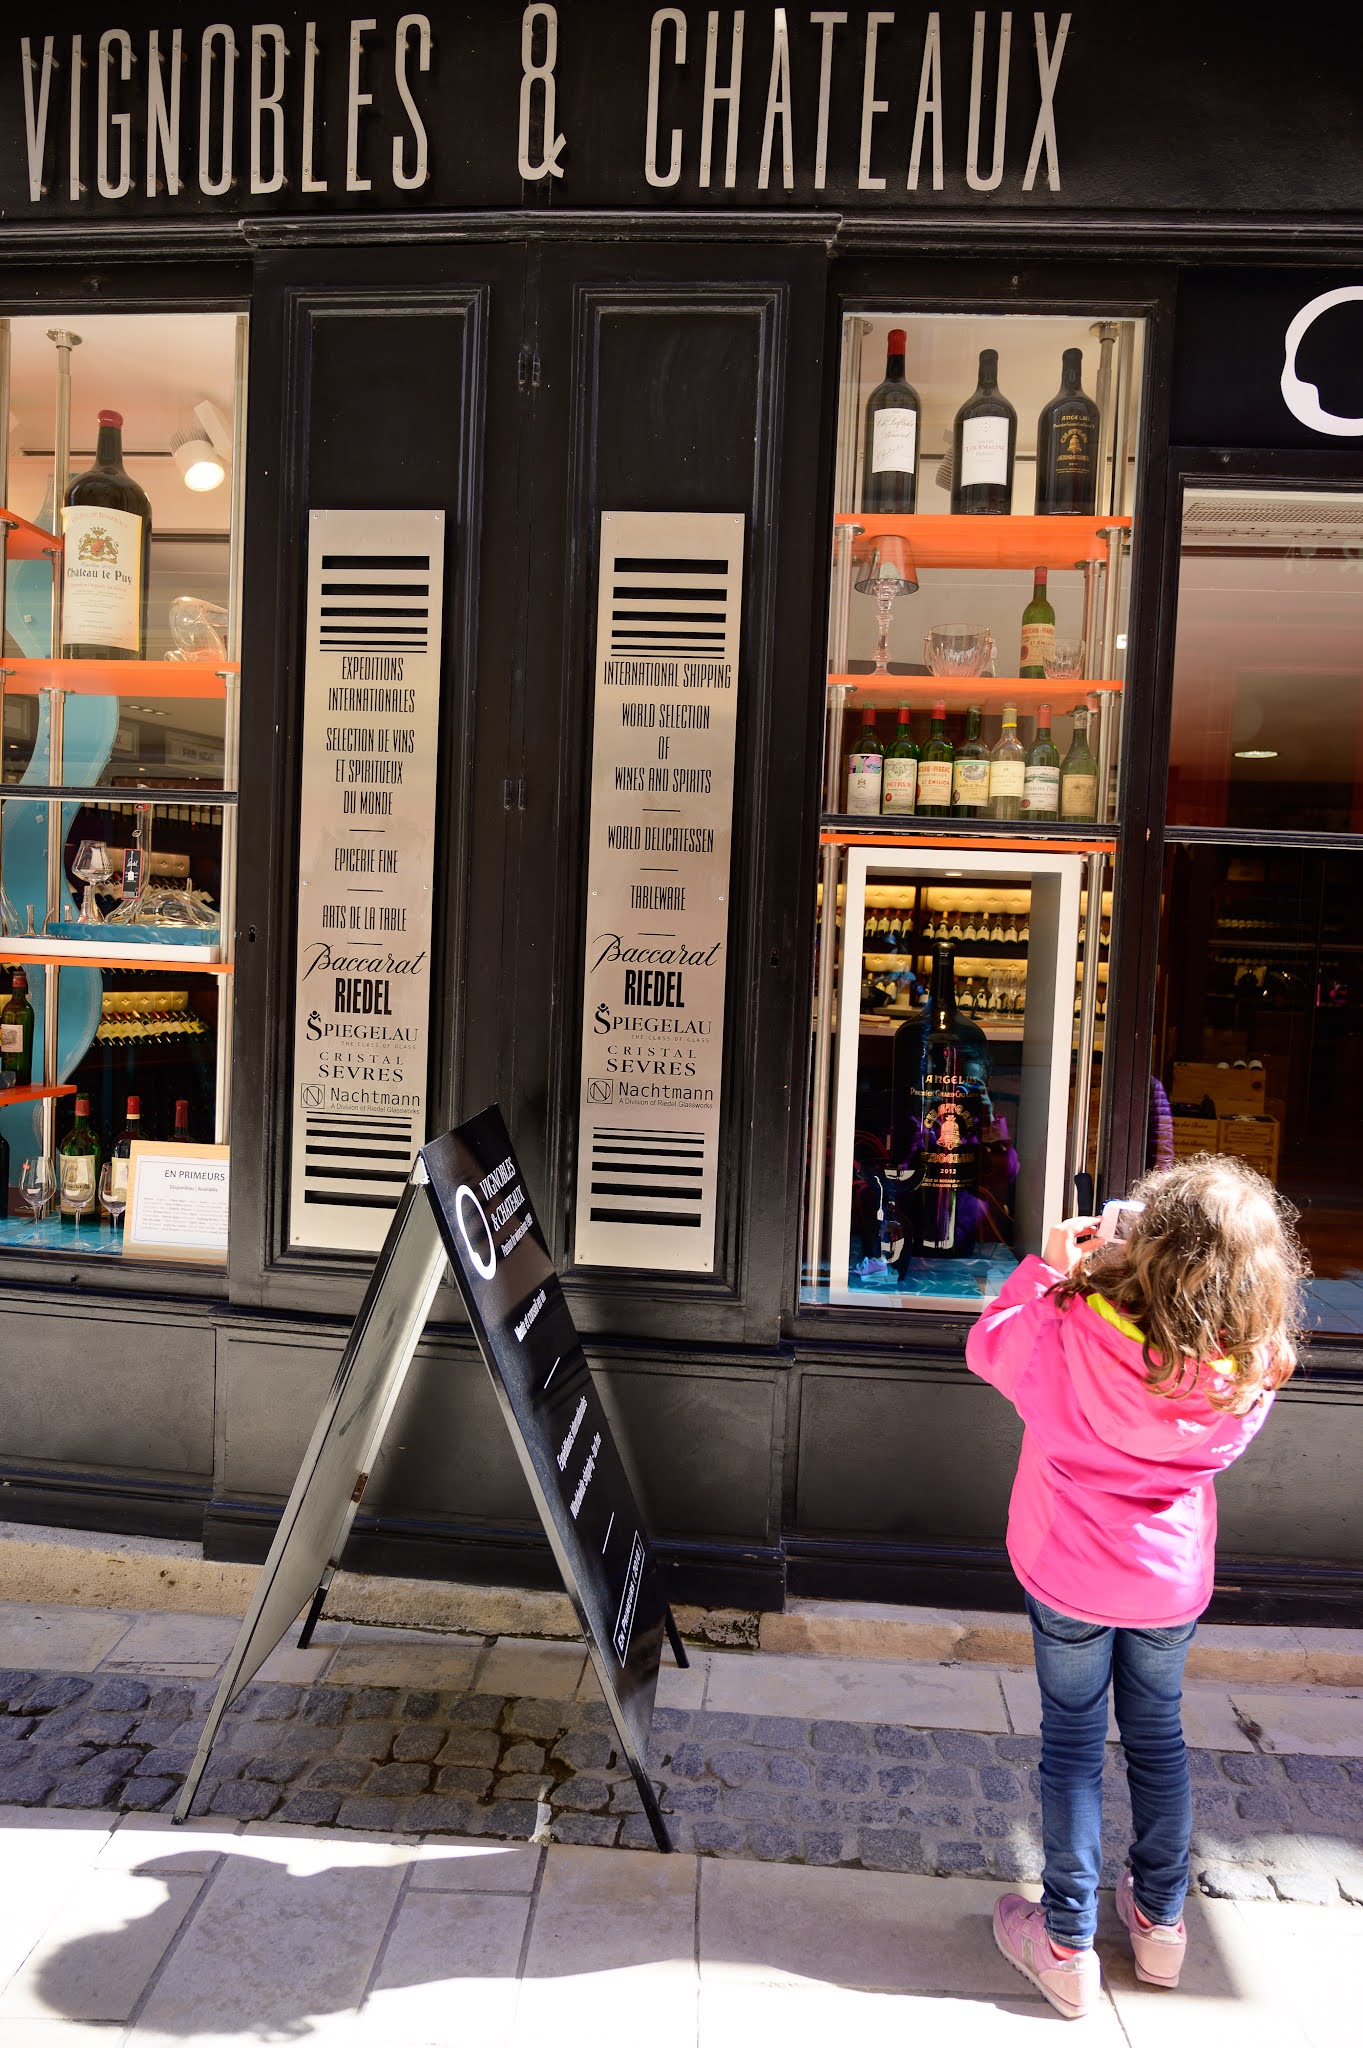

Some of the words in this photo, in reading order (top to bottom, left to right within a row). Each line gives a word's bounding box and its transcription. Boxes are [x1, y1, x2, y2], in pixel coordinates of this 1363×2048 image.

[20, 23, 433, 202] VIGNOBLES
[516, 2, 567, 180] &
[645, 7, 1073, 191] CHATEAUX
[115, 570, 132, 585] Puy
[342, 657, 403, 681] EXPEDITIONS
[604, 661, 679, 687] INTERNATIONAL
[683, 663, 731, 688] SHIPPING
[329, 688, 415, 713] INTERNATIONALES
[622, 703, 655, 727] WORLD
[659, 704, 710, 729] SELECTION
[326, 728, 374, 752] SELECTION
[378, 729, 389, 752] DE
[393, 730, 414, 753] VINS
[658, 736, 670, 760] OF
[336, 759, 345, 782] ET
[349, 760, 403, 784] SPIRITUEUX
[615, 767, 644, 791] WINES
[648, 768, 668, 791] AND
[673, 769, 711, 793] SPIRITS
[344, 791, 356, 814] DU
[360, 791, 393, 815] MONDE
[608, 826, 640, 849] WORLD
[645, 827, 714, 852] DELICATESSEN
[335, 848, 375, 872] EPICERIE
[379, 850, 398, 873] FINE
[631, 885, 686, 911] TABLEWARE
[323, 905, 346, 928] ARTS
[350, 906, 361, 929] DE
[365, 907, 375, 929] LA
[379, 907, 407, 931] TABLE
[302, 943, 427, 981] Baccarat
[590, 933, 722, 973] Baccarat
[335, 978, 392, 1015] RIEDEL
[624, 969, 685, 1008] RIEDEL
[319, 1052, 404, 1066] CRISTAL
[607, 1045, 696, 1058] CRISTAL
[319, 1064, 403, 1082] SEVRES
[606, 1058, 696, 1077] SEVRES
[331, 1087, 420, 1106] Nachtmann
[619, 1082, 713, 1100] Nachtmann
[387, 1106, 420, 1115] Glassworks
[678, 1101, 713, 1109] Glassworks
[164, 1169, 177, 1178] EN
[179, 1170, 226, 1181] PRIMEURS
[479, 1156, 516, 1201] VIGNOBLES
[490, 1213, 501, 1232] &
[496, 1185, 526, 1226] CHATEAUX
